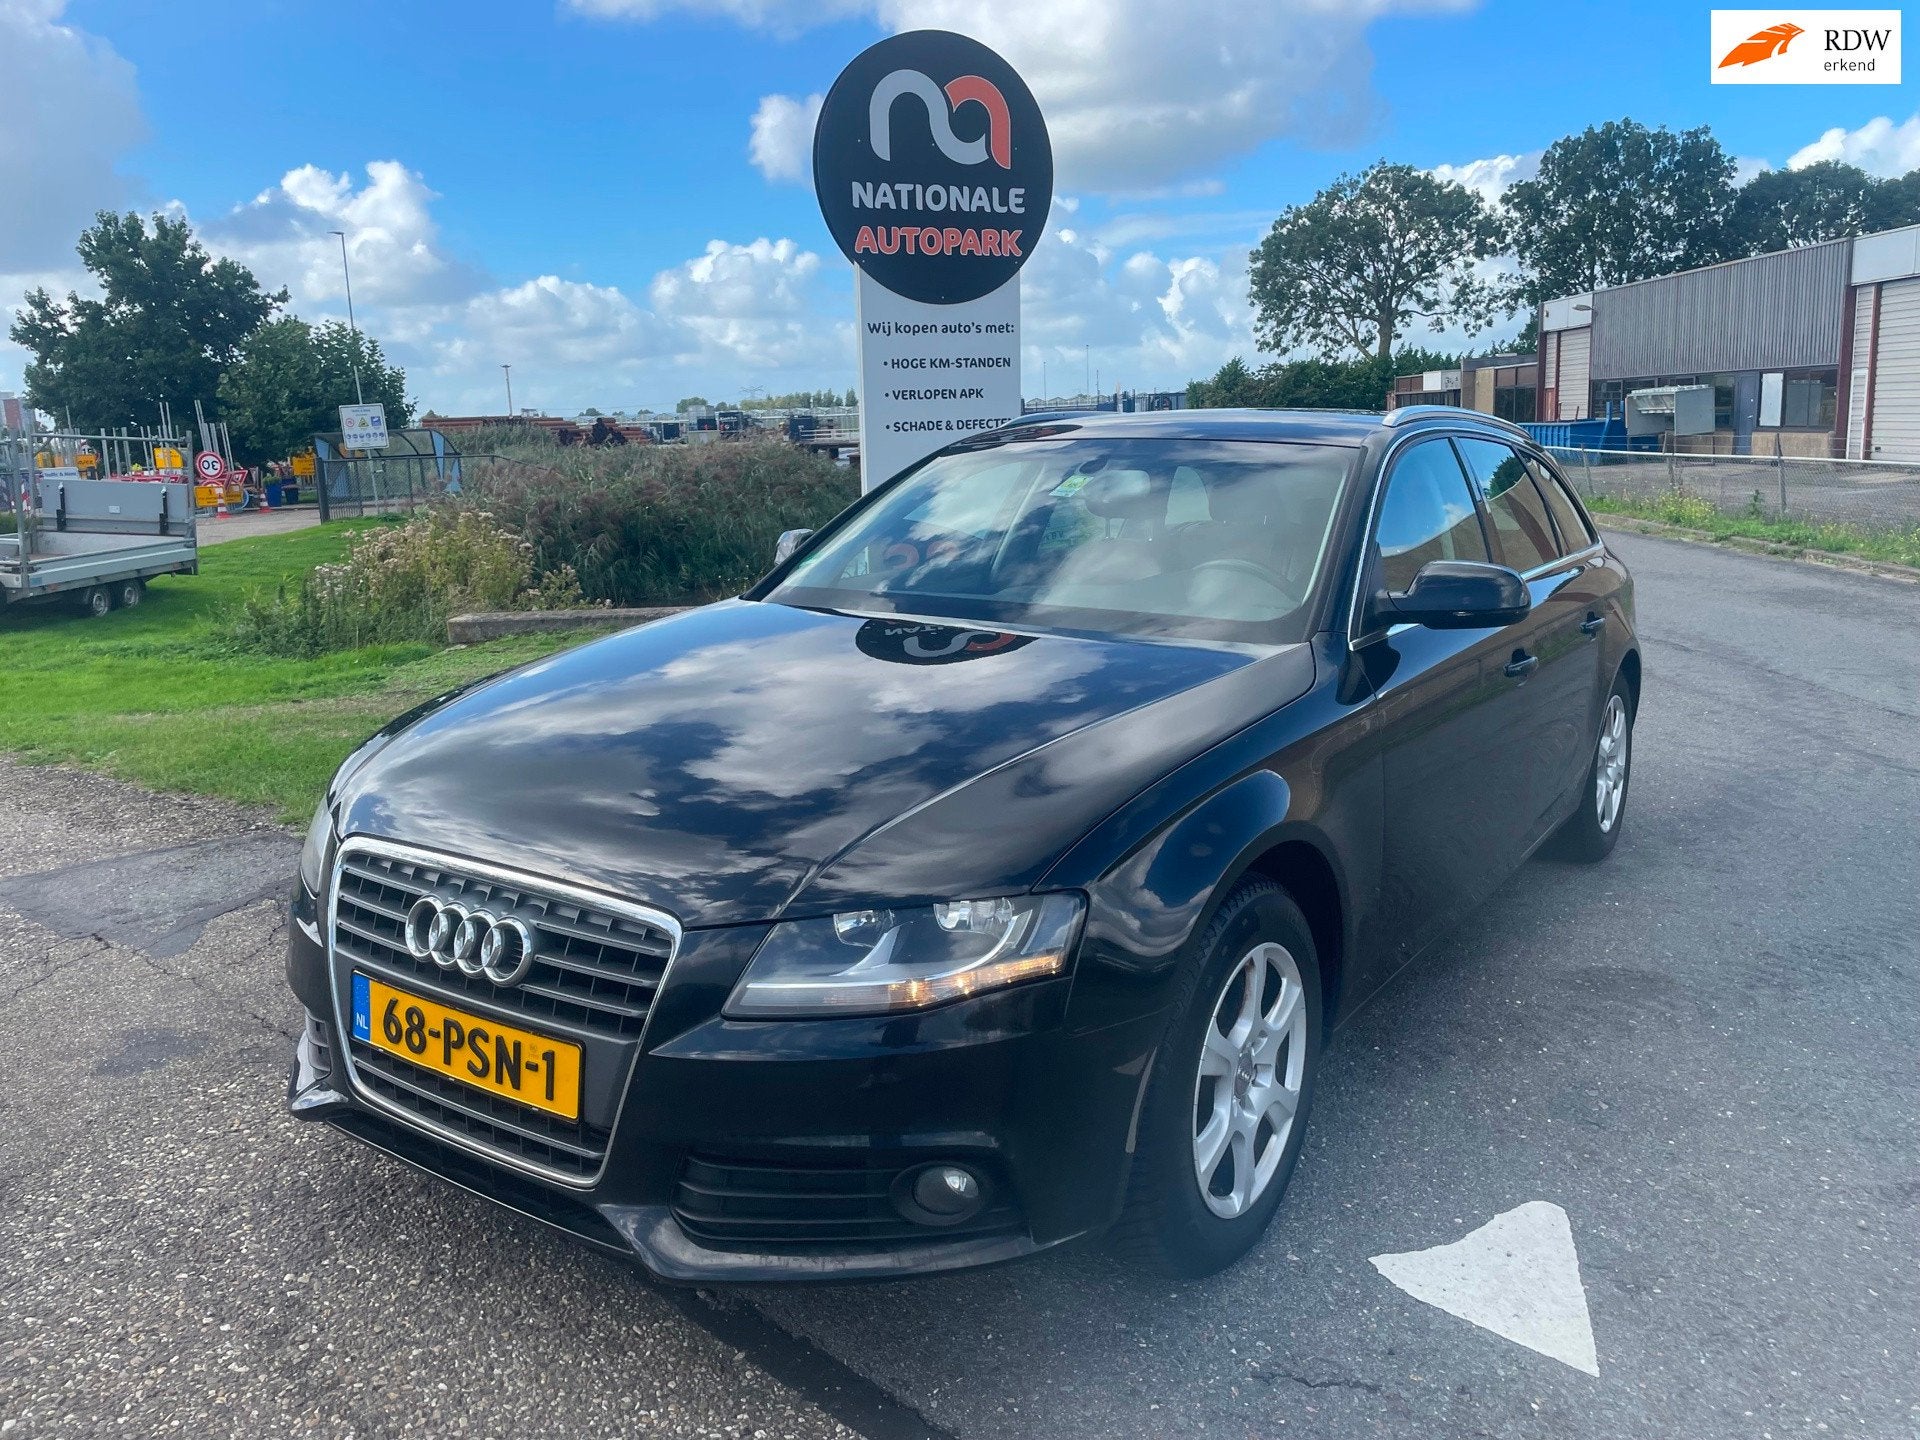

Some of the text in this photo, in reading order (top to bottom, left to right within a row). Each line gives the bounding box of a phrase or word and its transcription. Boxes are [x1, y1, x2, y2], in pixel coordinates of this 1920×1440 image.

[851, 181, 1026, 214] NATIONALE
[854, 225, 1023, 257] AUTOPARK
[867, 321, 1015, 337] Wij kopen auto's met:
[891, 357, 1011, 370] HOGE KM-STANDEN
[892, 388, 984, 400] VERLOPEN APK
[893, 420, 943, 432] SCHADE
[945, 420, 954, 431] &
[201, 460, 219, 470] 30
[355, 1011, 369, 1031] NL
[383, 997, 555, 1101] 68-PSN-1
